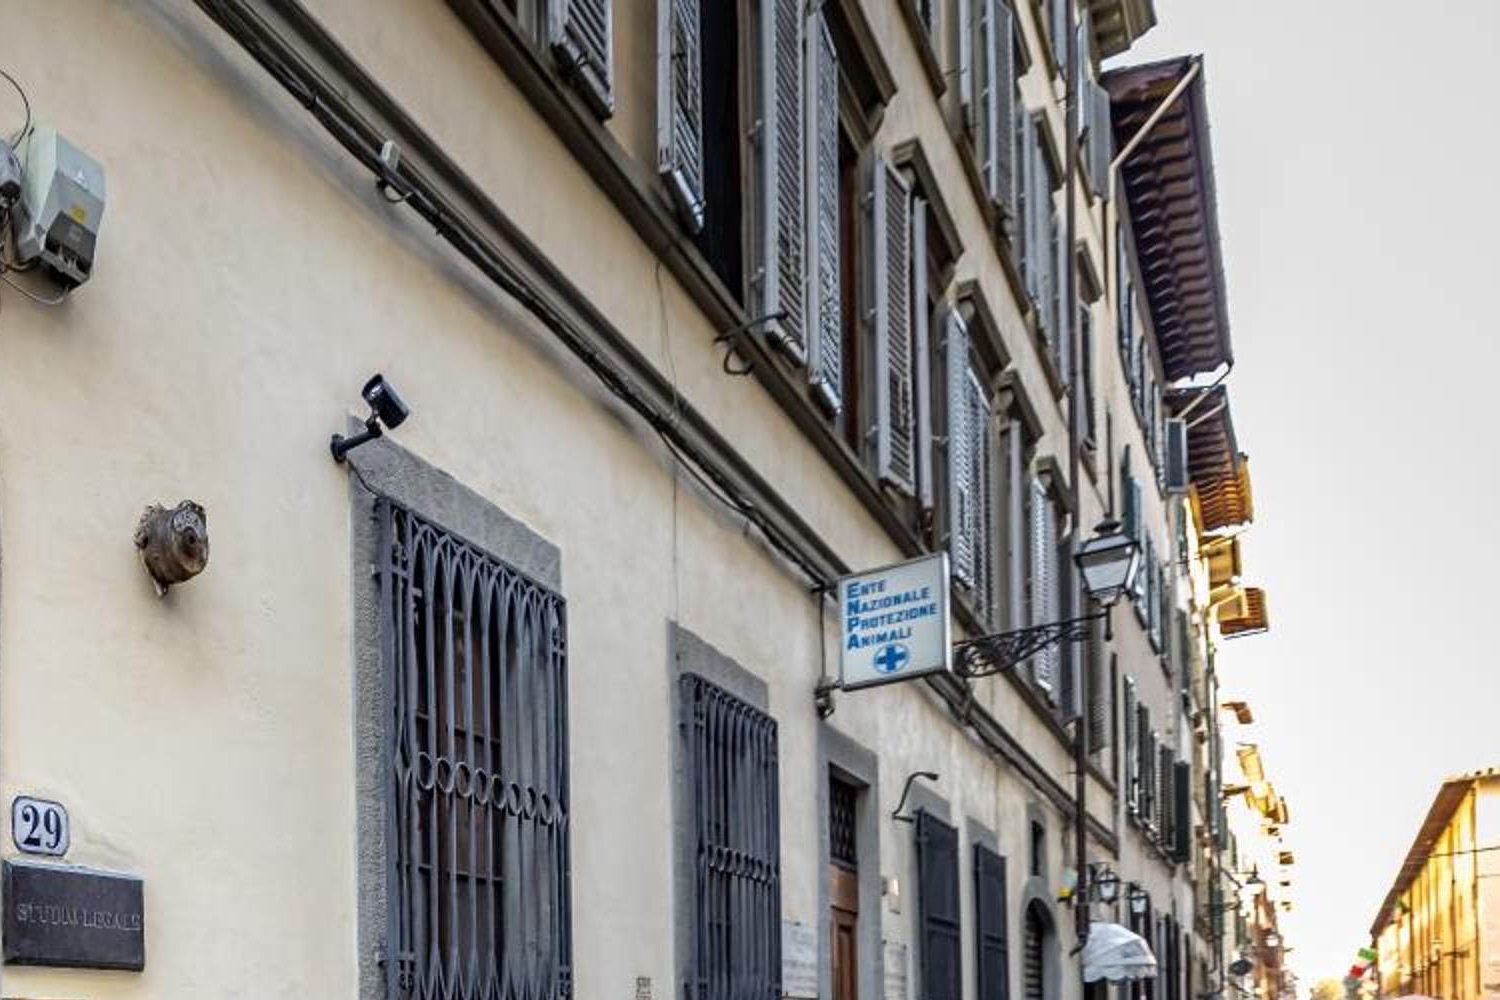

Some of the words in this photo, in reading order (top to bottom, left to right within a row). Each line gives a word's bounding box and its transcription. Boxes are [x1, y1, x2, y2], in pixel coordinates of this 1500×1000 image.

[847, 587, 931, 615] NAZIONALE
[847, 603, 937, 632] PROTEZIONE
[847, 627, 912, 649] ANIMALI
[22, 804, 62, 849] 29
